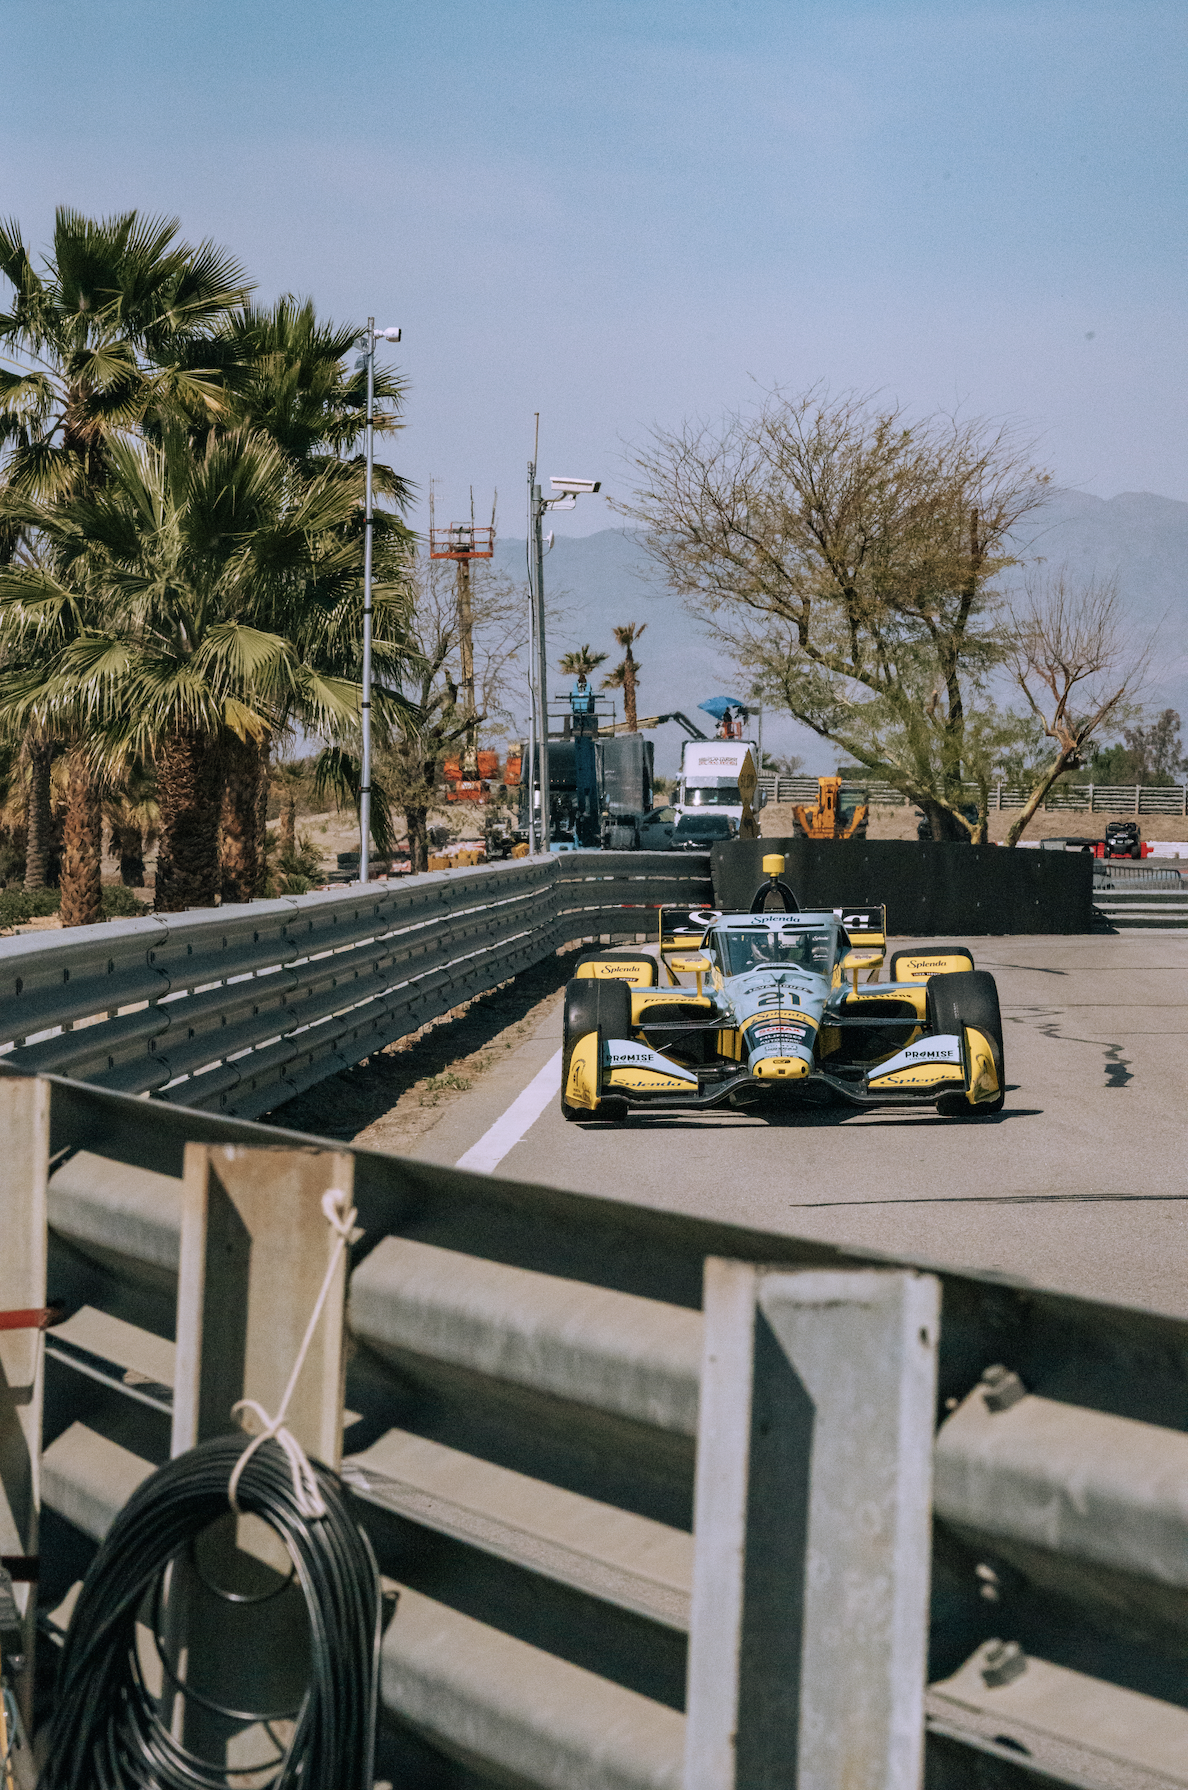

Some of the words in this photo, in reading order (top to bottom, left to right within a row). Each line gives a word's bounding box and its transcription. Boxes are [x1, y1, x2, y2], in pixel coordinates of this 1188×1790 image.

[751, 915, 801, 925] Splenda
[907, 960, 947, 969] Splenda
[601, 965, 640, 974] Splenda
[758, 991, 801, 1007] 21
[905, 1050, 954, 1058] PROMISE
[613, 1078, 681, 1087] Splenda
[880, 1075, 956, 1084] Splenda
